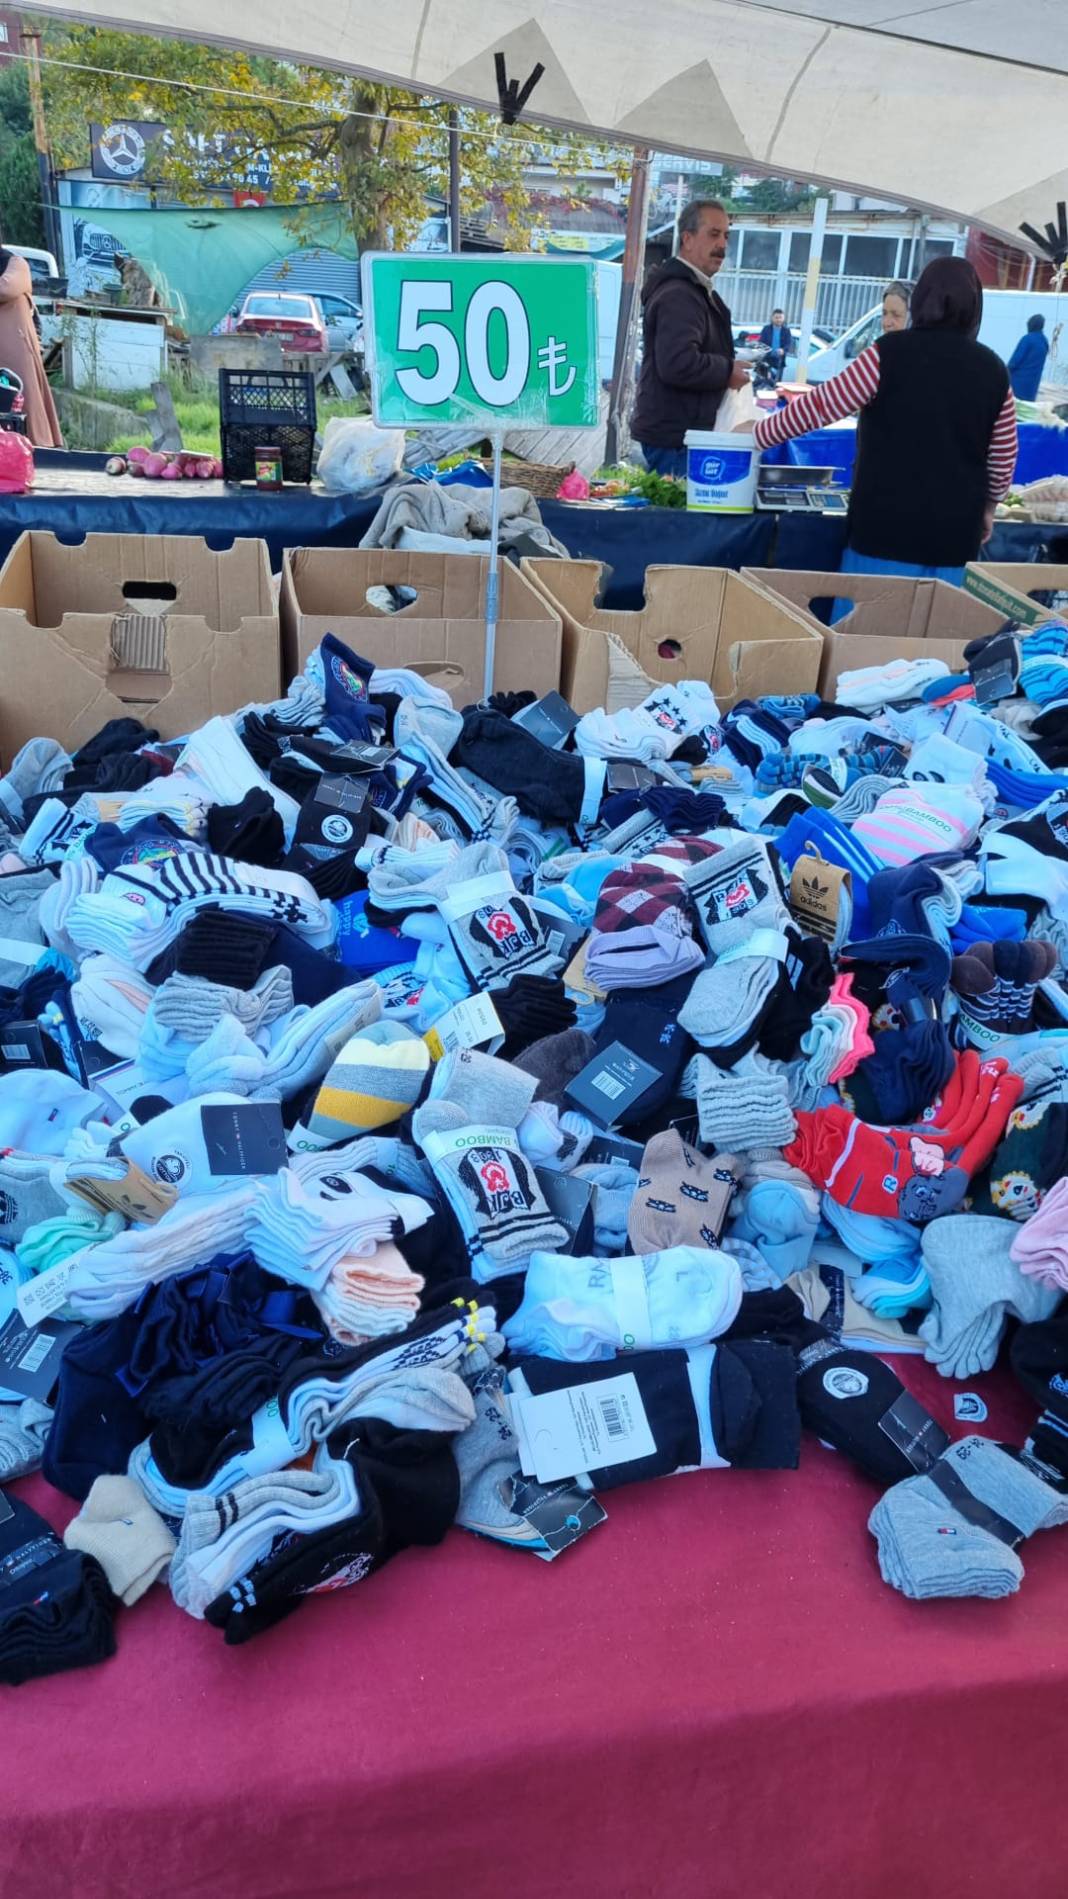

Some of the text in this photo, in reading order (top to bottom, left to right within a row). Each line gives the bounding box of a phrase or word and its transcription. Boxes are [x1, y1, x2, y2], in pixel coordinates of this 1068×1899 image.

[903, 806, 952, 832] BAMBOO
[800, 895, 827, 912] adidas
[342, 900, 354, 936] happy
[960, 1013, 1001, 1043] AMBOO
[455, 1134, 511, 1148] BAMBOO
